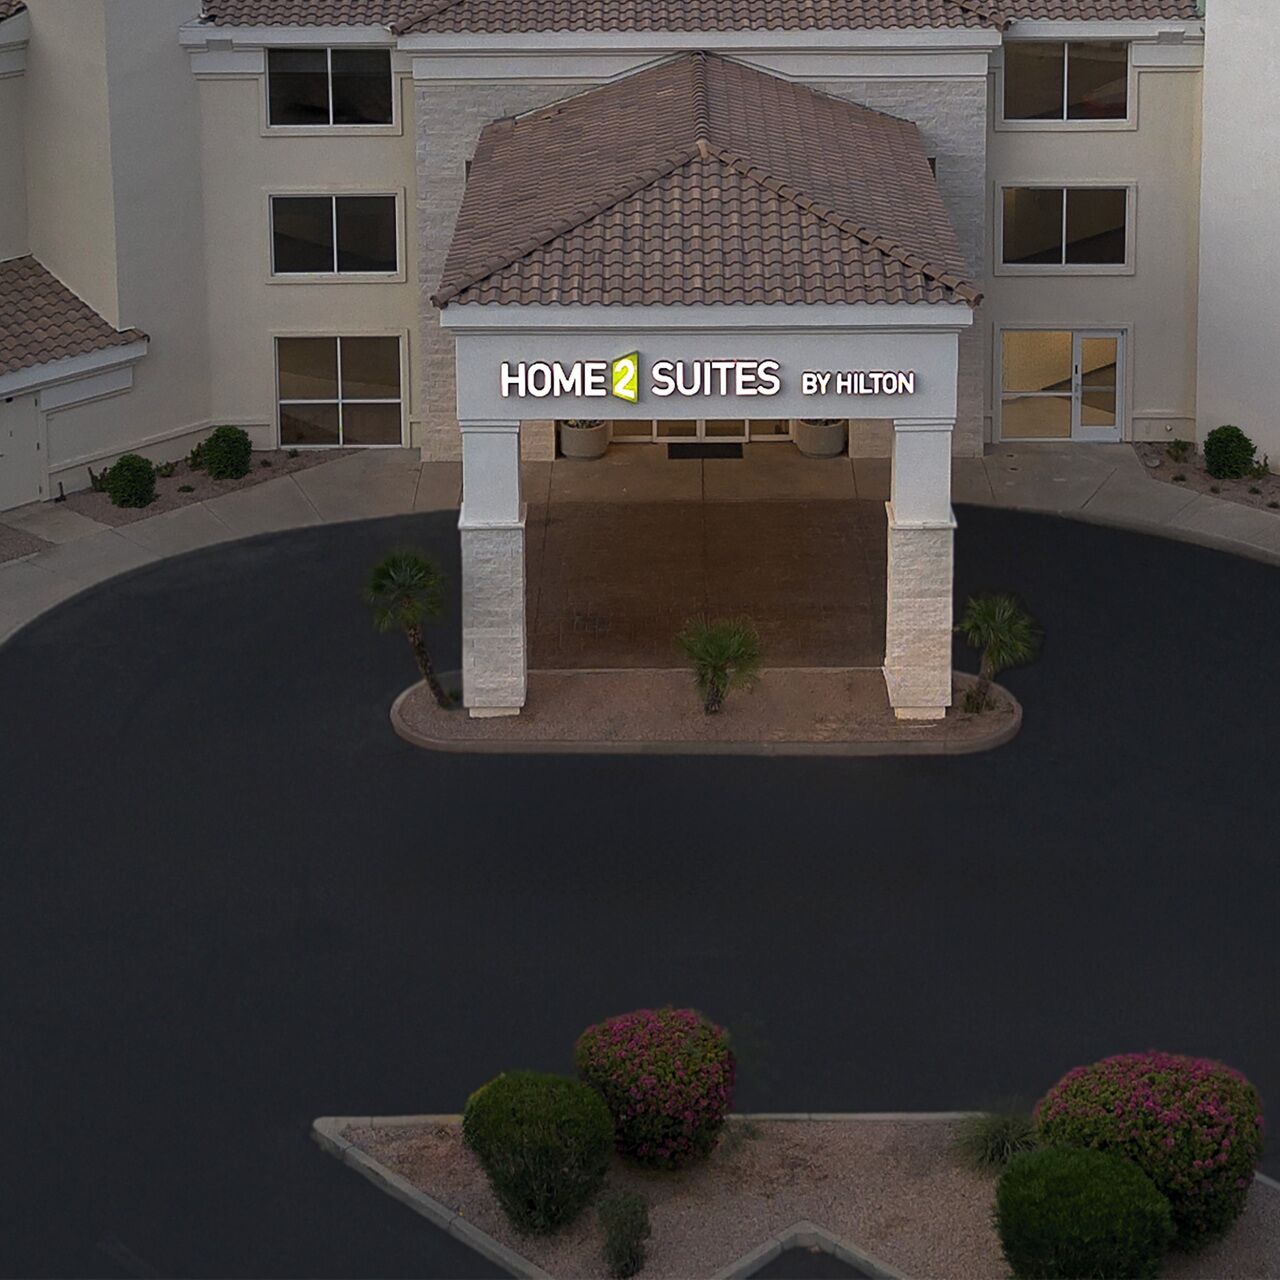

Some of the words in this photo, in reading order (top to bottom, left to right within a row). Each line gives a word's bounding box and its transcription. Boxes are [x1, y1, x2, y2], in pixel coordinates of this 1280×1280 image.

[651, 359, 781, 397] SUITES
[801, 370, 830, 395] BY
[835, 370, 915, 395] HILTON
